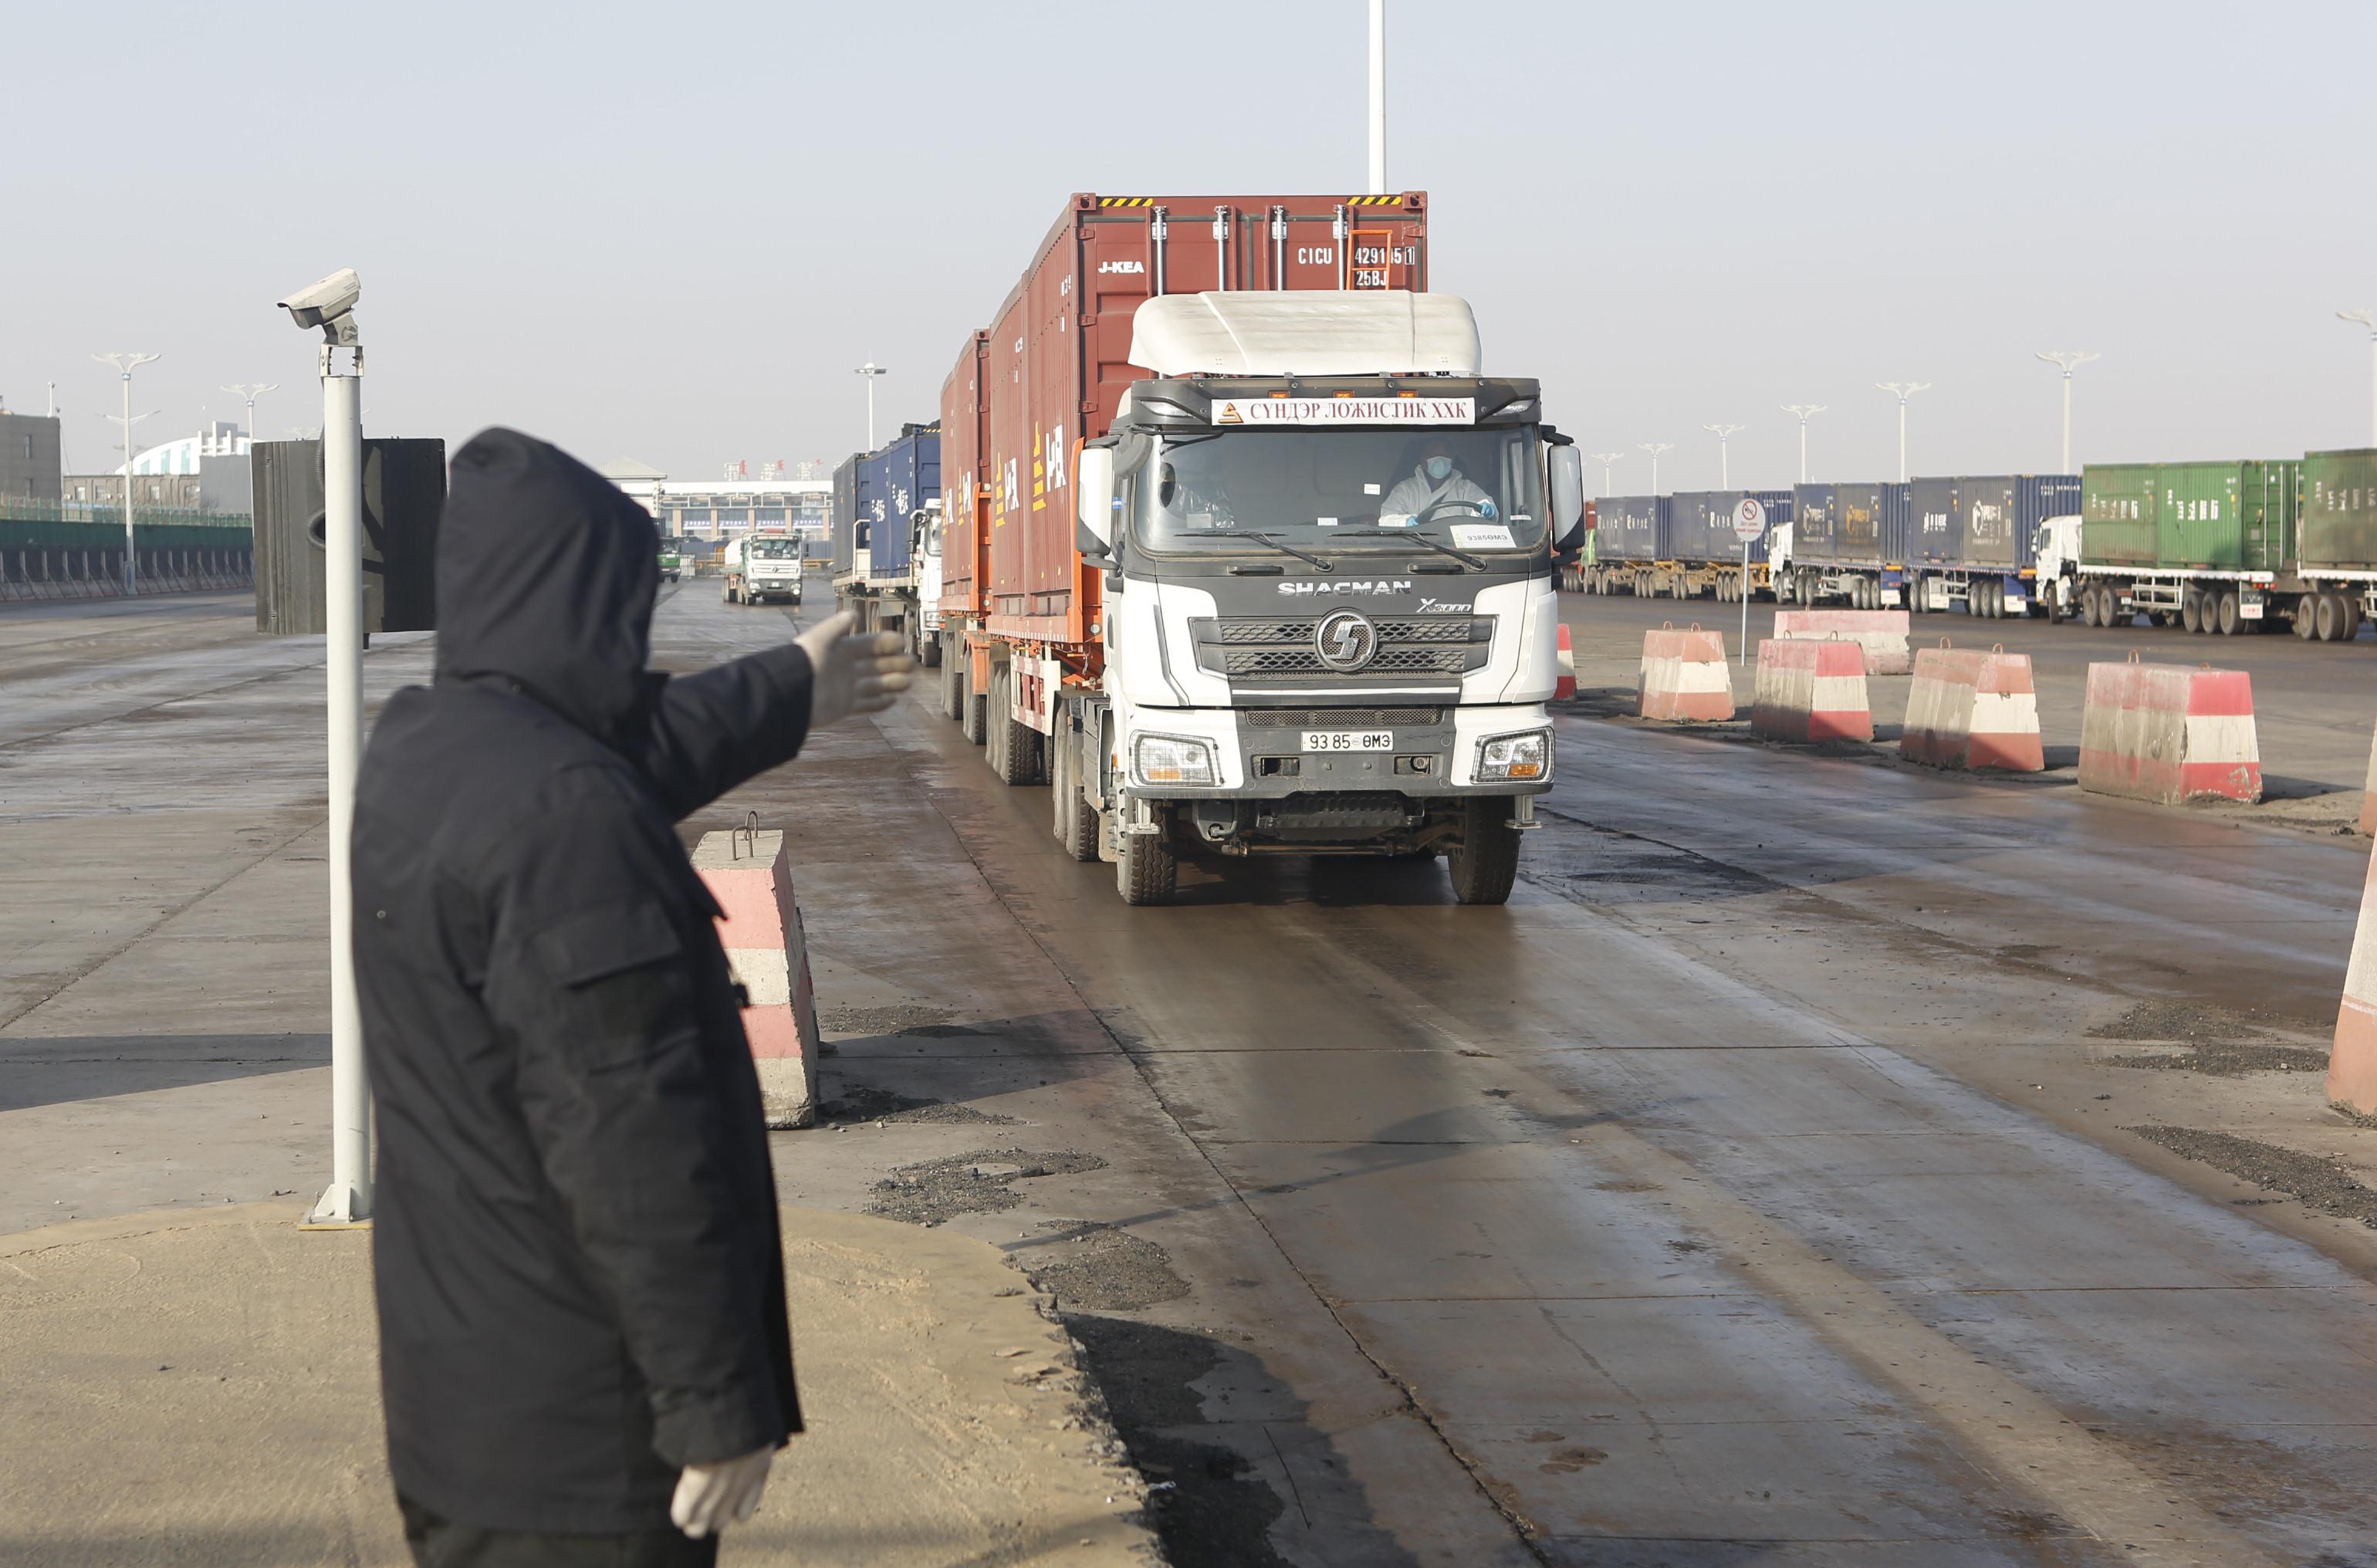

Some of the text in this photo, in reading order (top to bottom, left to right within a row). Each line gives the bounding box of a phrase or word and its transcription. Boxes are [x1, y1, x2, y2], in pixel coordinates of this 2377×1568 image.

[1298, 248, 1333, 265] CICU
[1097, 261, 1145, 273] J-KEA
[1250, 401, 1466, 421] СҮНДЭР ЛОЖИСТИК ХХК
[1278, 580, 1412, 596] SHACMAN
[1416, 598, 1472, 613] X3000
